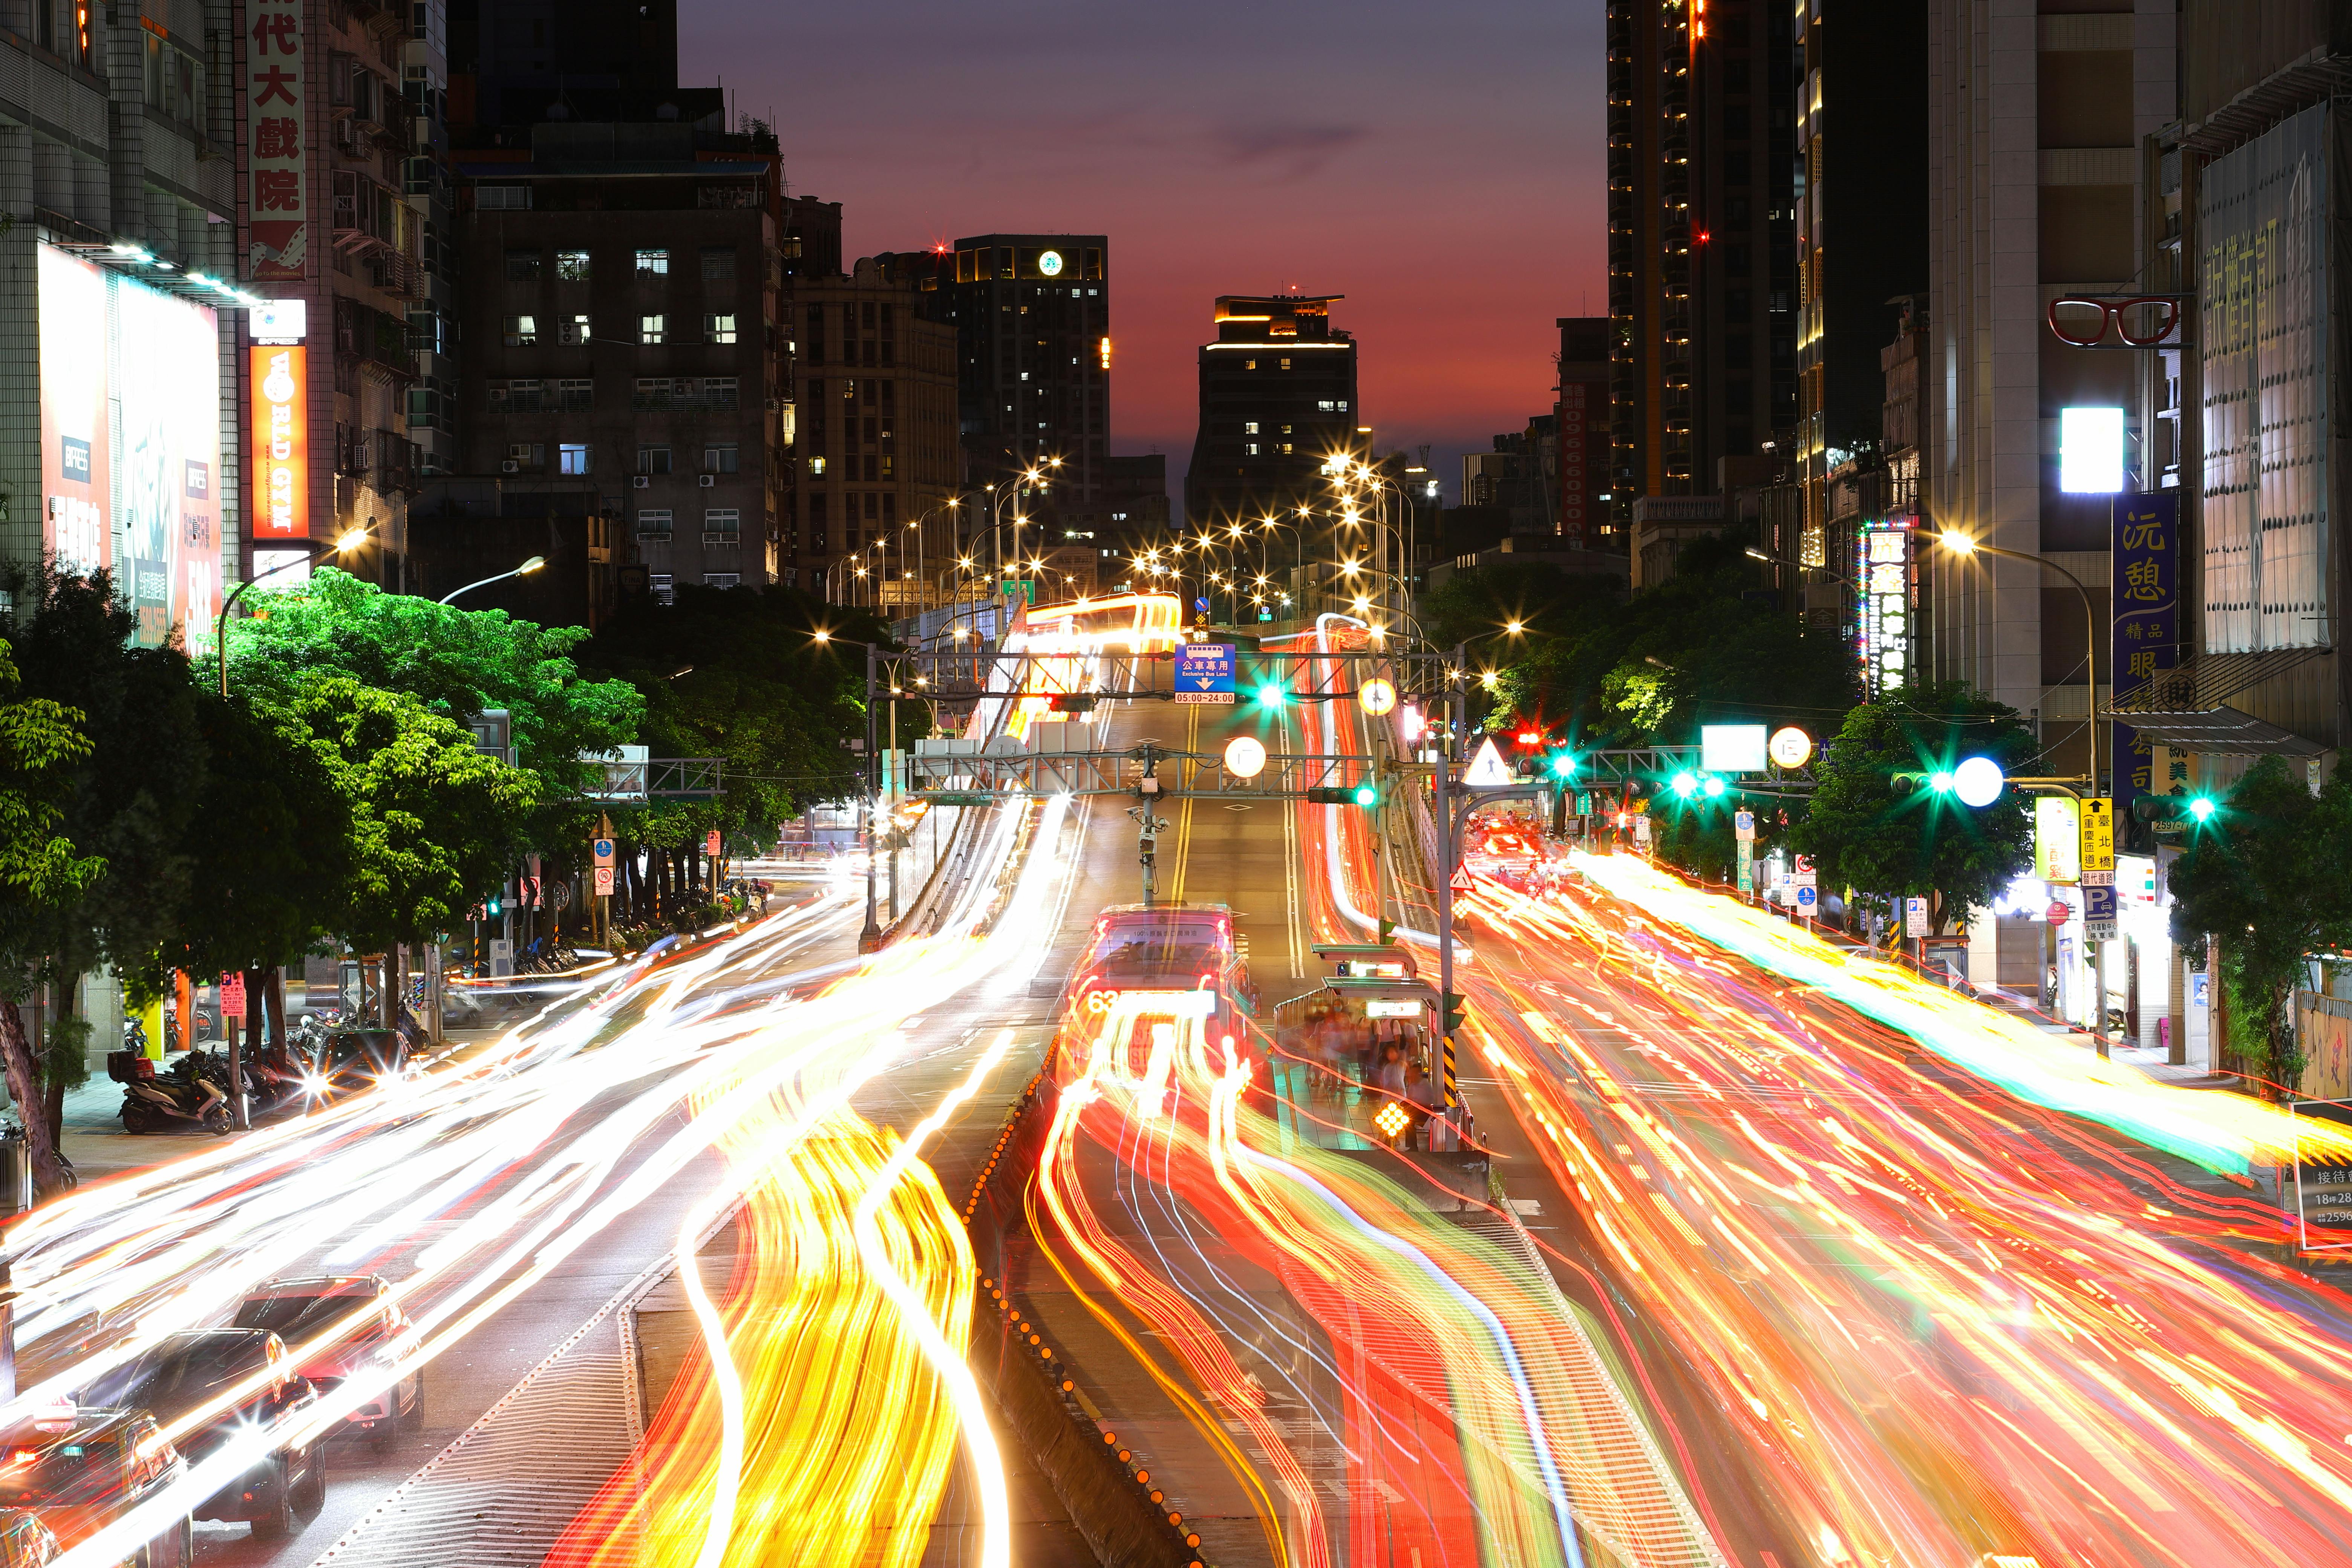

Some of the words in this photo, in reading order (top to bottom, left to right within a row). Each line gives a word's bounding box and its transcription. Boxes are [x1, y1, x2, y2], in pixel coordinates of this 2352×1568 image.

[251, 0, 299, 212] 代大戲院
[1562, 385, 1585, 397] 廣告
[263, 351, 295, 460] WORLD
[1562, 398, 1585, 409] 出租
[272, 467, 291, 529] GYM
[1869, 532, 1905, 594] 麗鑫
[2122, 511, 2165, 600] 沅憩
[2125, 623, 2163, 640] 精品
[1182, 661, 1228, 671] 公車專用
[2098, 815, 2111, 868] 臺北橋
[2083, 873, 2113, 884] 替代道路
[1910, 902, 1916, 910] P
[2086, 889, 2109, 911] P
[2086, 923, 2116, 931] 大同運動中心
[223, 974, 230, 983] P
